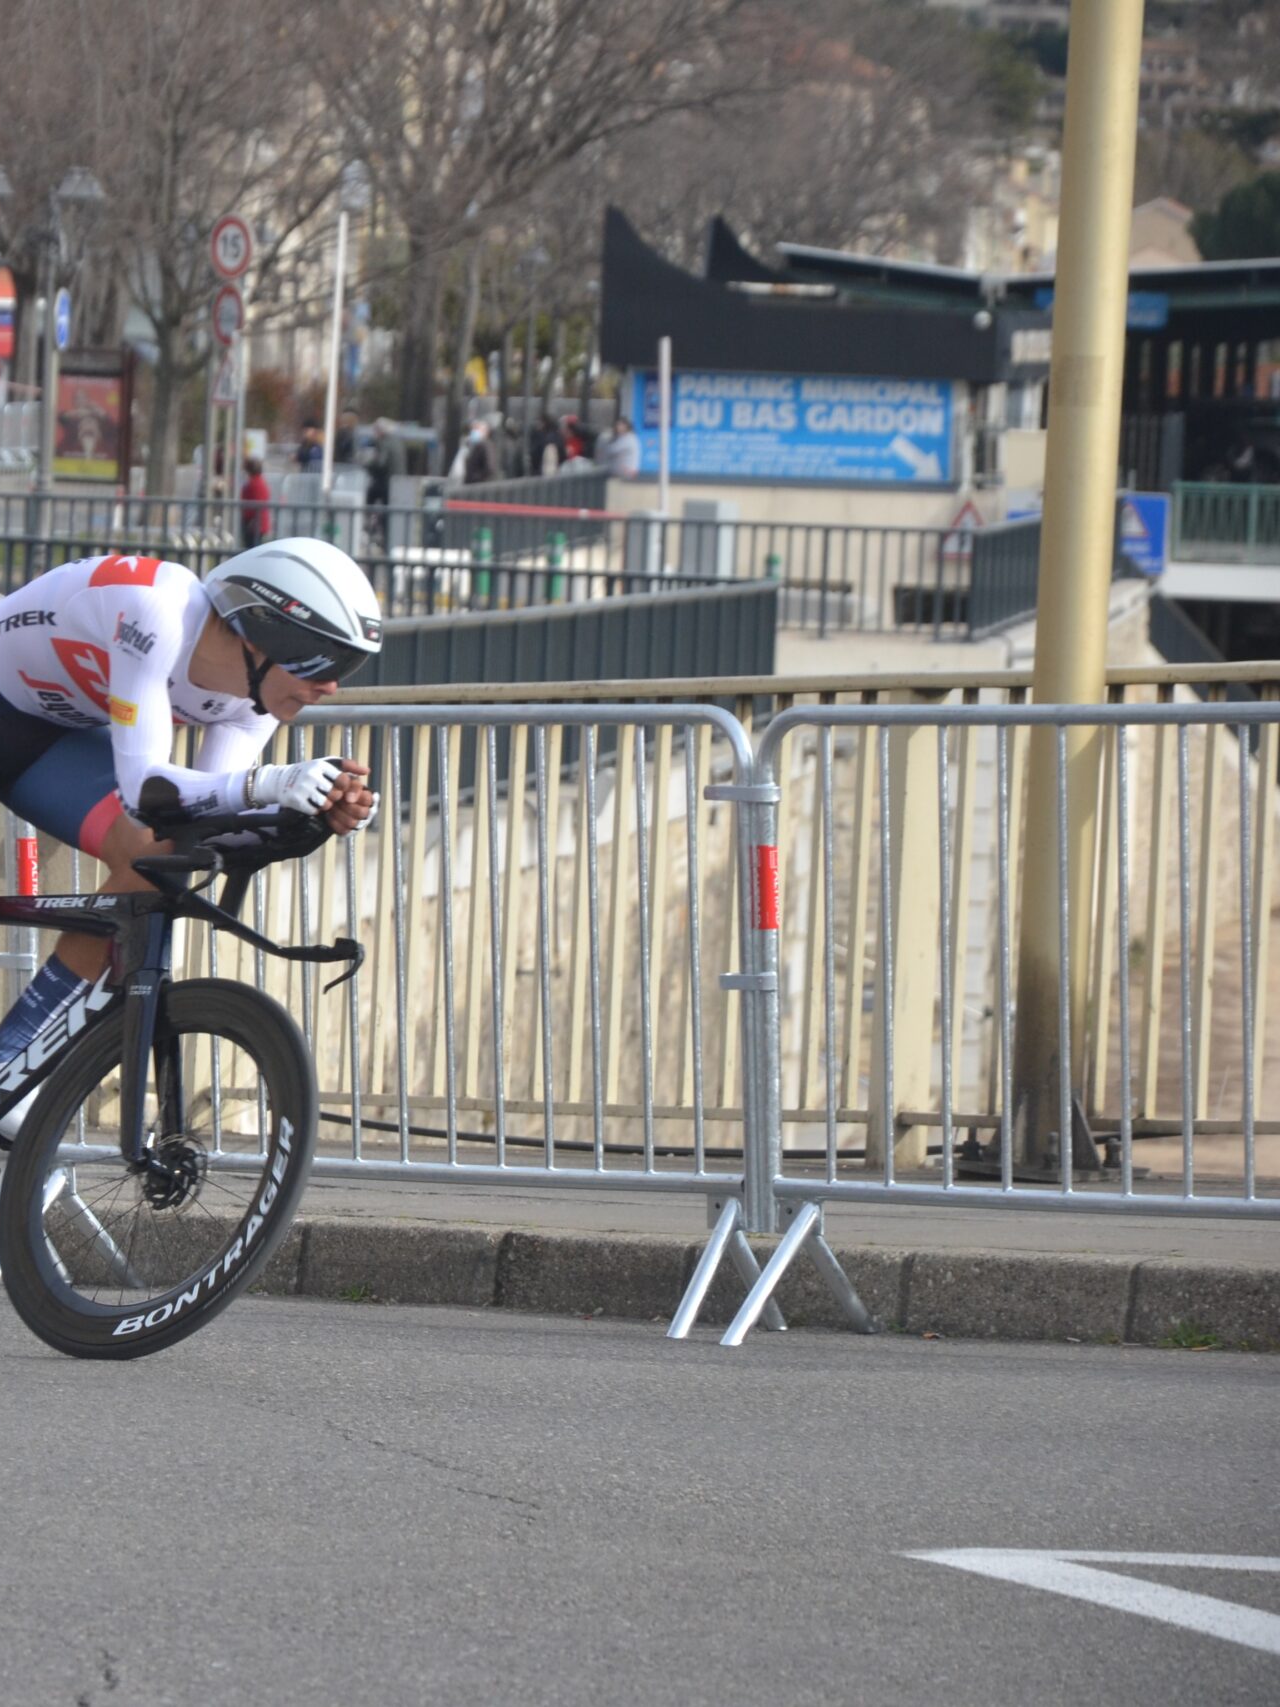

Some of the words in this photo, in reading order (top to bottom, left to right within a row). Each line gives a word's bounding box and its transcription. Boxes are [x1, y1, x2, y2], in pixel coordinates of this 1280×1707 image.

[222, 234, 241, 260] 15
[678, 376, 793, 398] PARKING
[801, 379, 943, 404] MUNICIPAL
[678, 401, 722, 427] DU
[733, 403, 796, 429] BAS
[805, 404, 944, 434] GARDON
[250, 581, 284, 604] TREK
[33, 896, 89, 908] TREK
[112, 1116, 294, 1335] BONTRAGER
